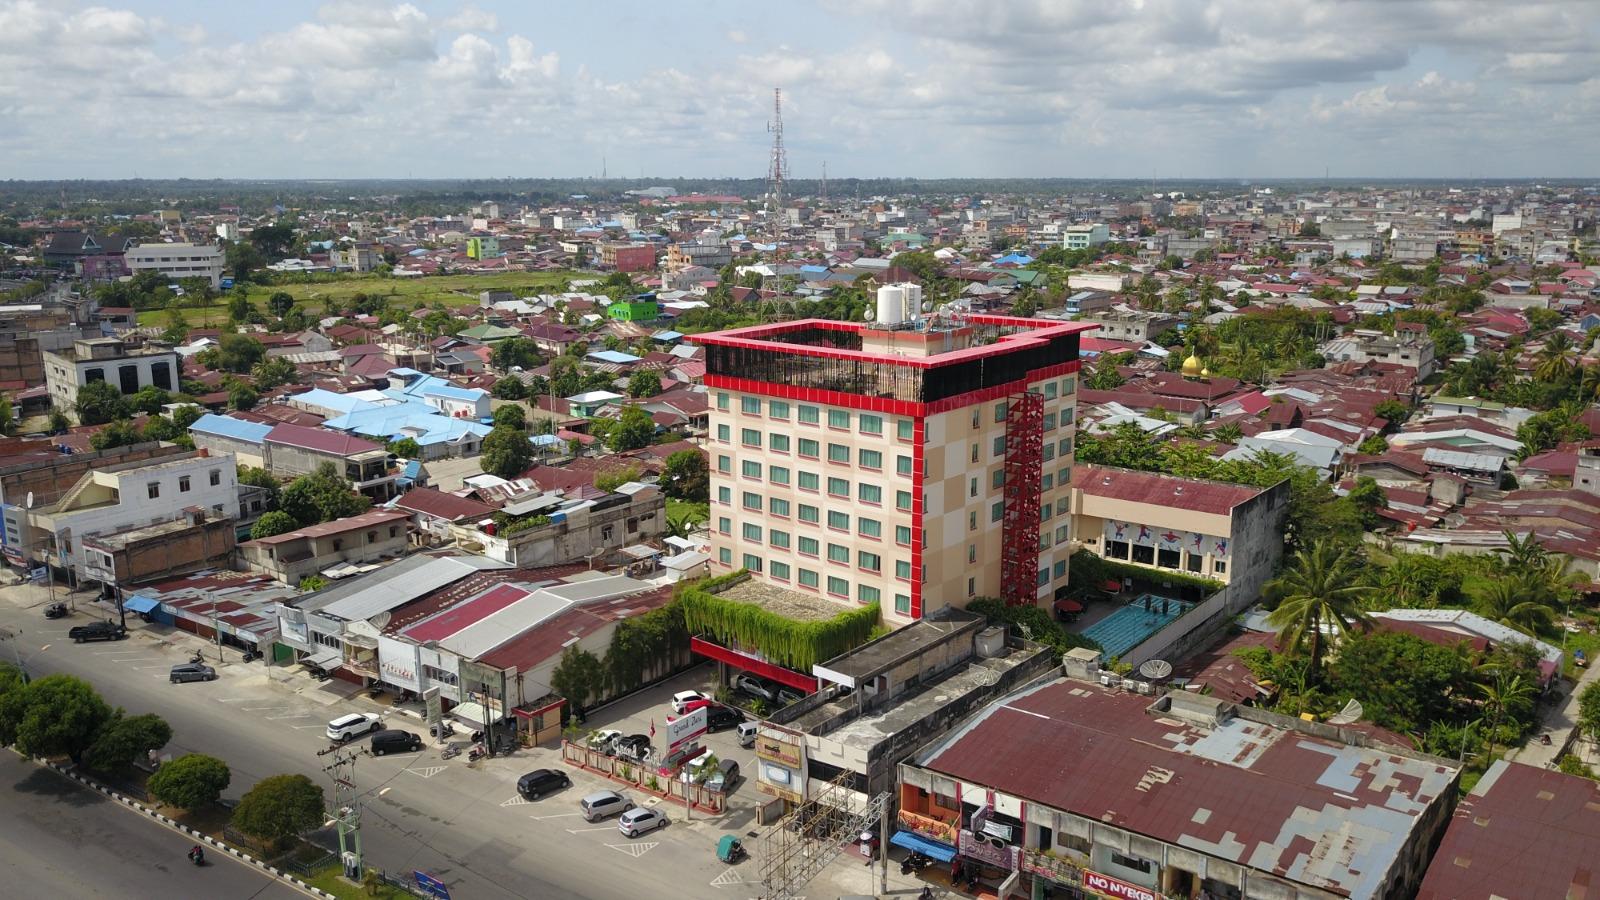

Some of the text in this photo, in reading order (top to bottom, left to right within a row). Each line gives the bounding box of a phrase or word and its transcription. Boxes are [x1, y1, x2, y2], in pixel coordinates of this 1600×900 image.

[673, 721, 690, 736] Grand
[611, 737, 639, 758] Grand
[1088, 875, 1108, 888] NO
